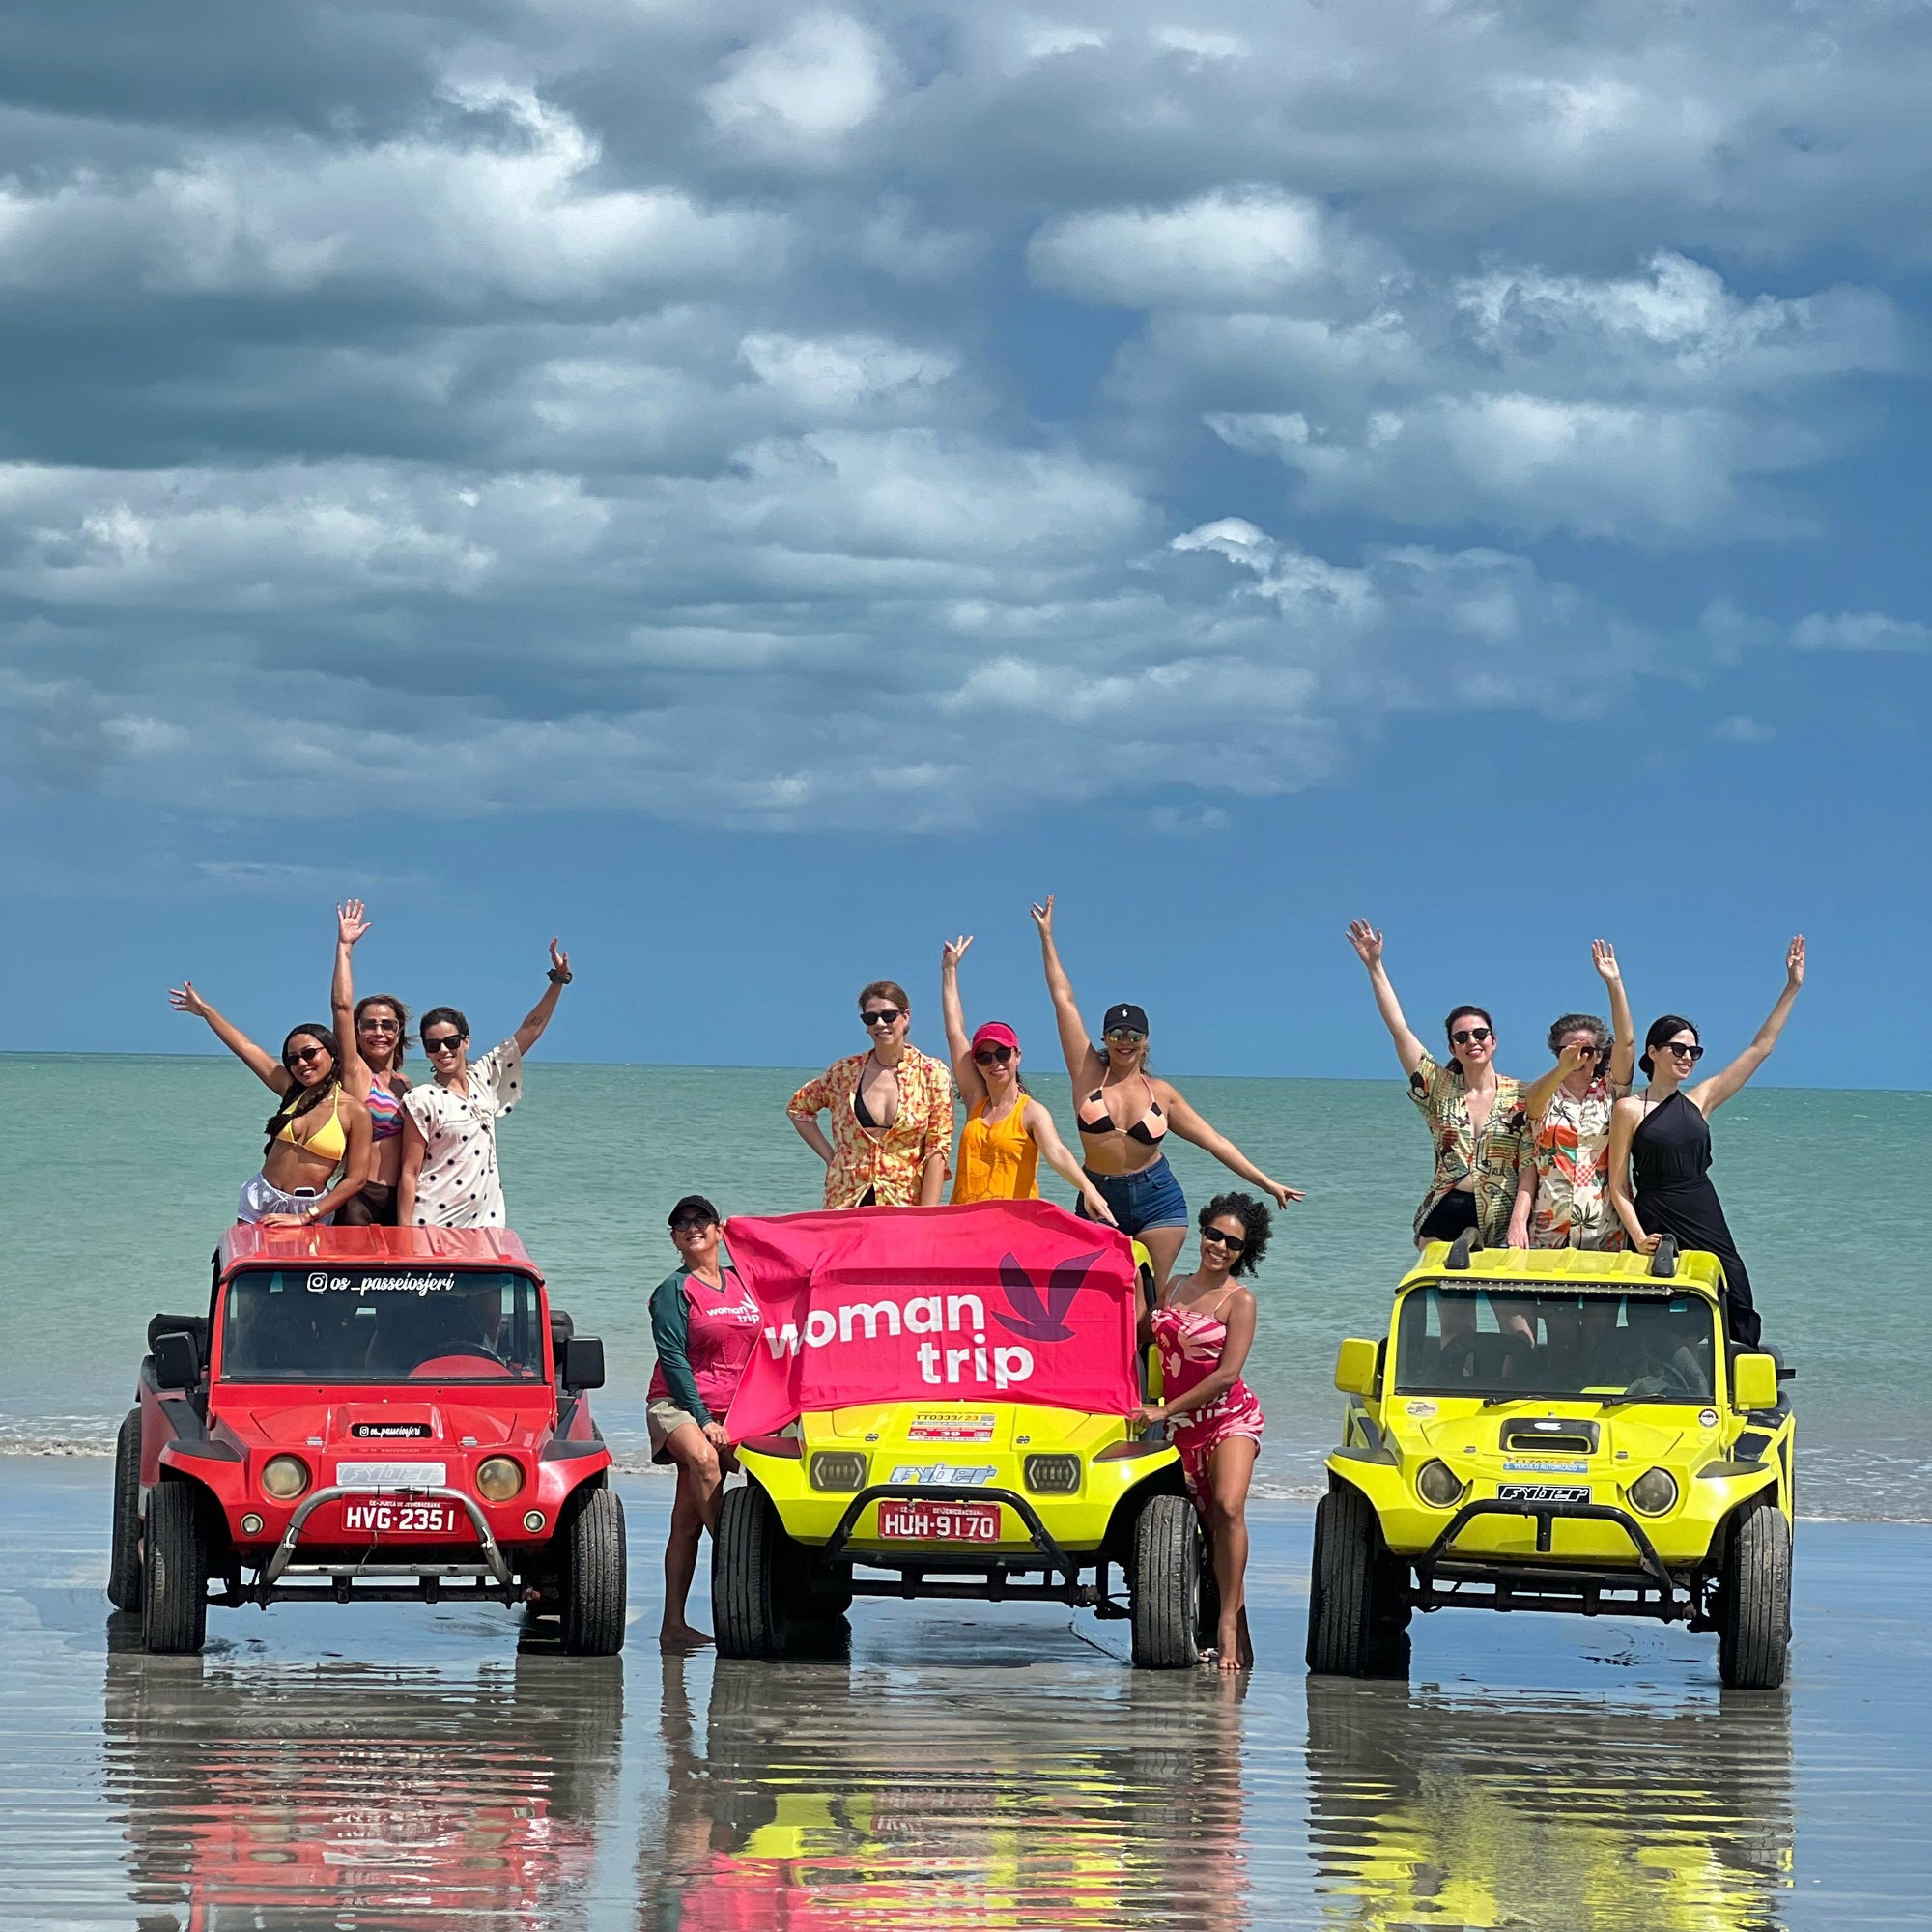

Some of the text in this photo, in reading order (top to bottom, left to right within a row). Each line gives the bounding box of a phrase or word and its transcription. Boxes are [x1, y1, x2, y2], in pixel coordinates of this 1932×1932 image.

[330, 1272, 455, 1296] os_passeiosjeri
[706, 1306, 749, 1317] woman
[736, 1313, 760, 1324] trip
[764, 1293, 985, 1360] woman
[916, 1333, 1035, 1390] trip
